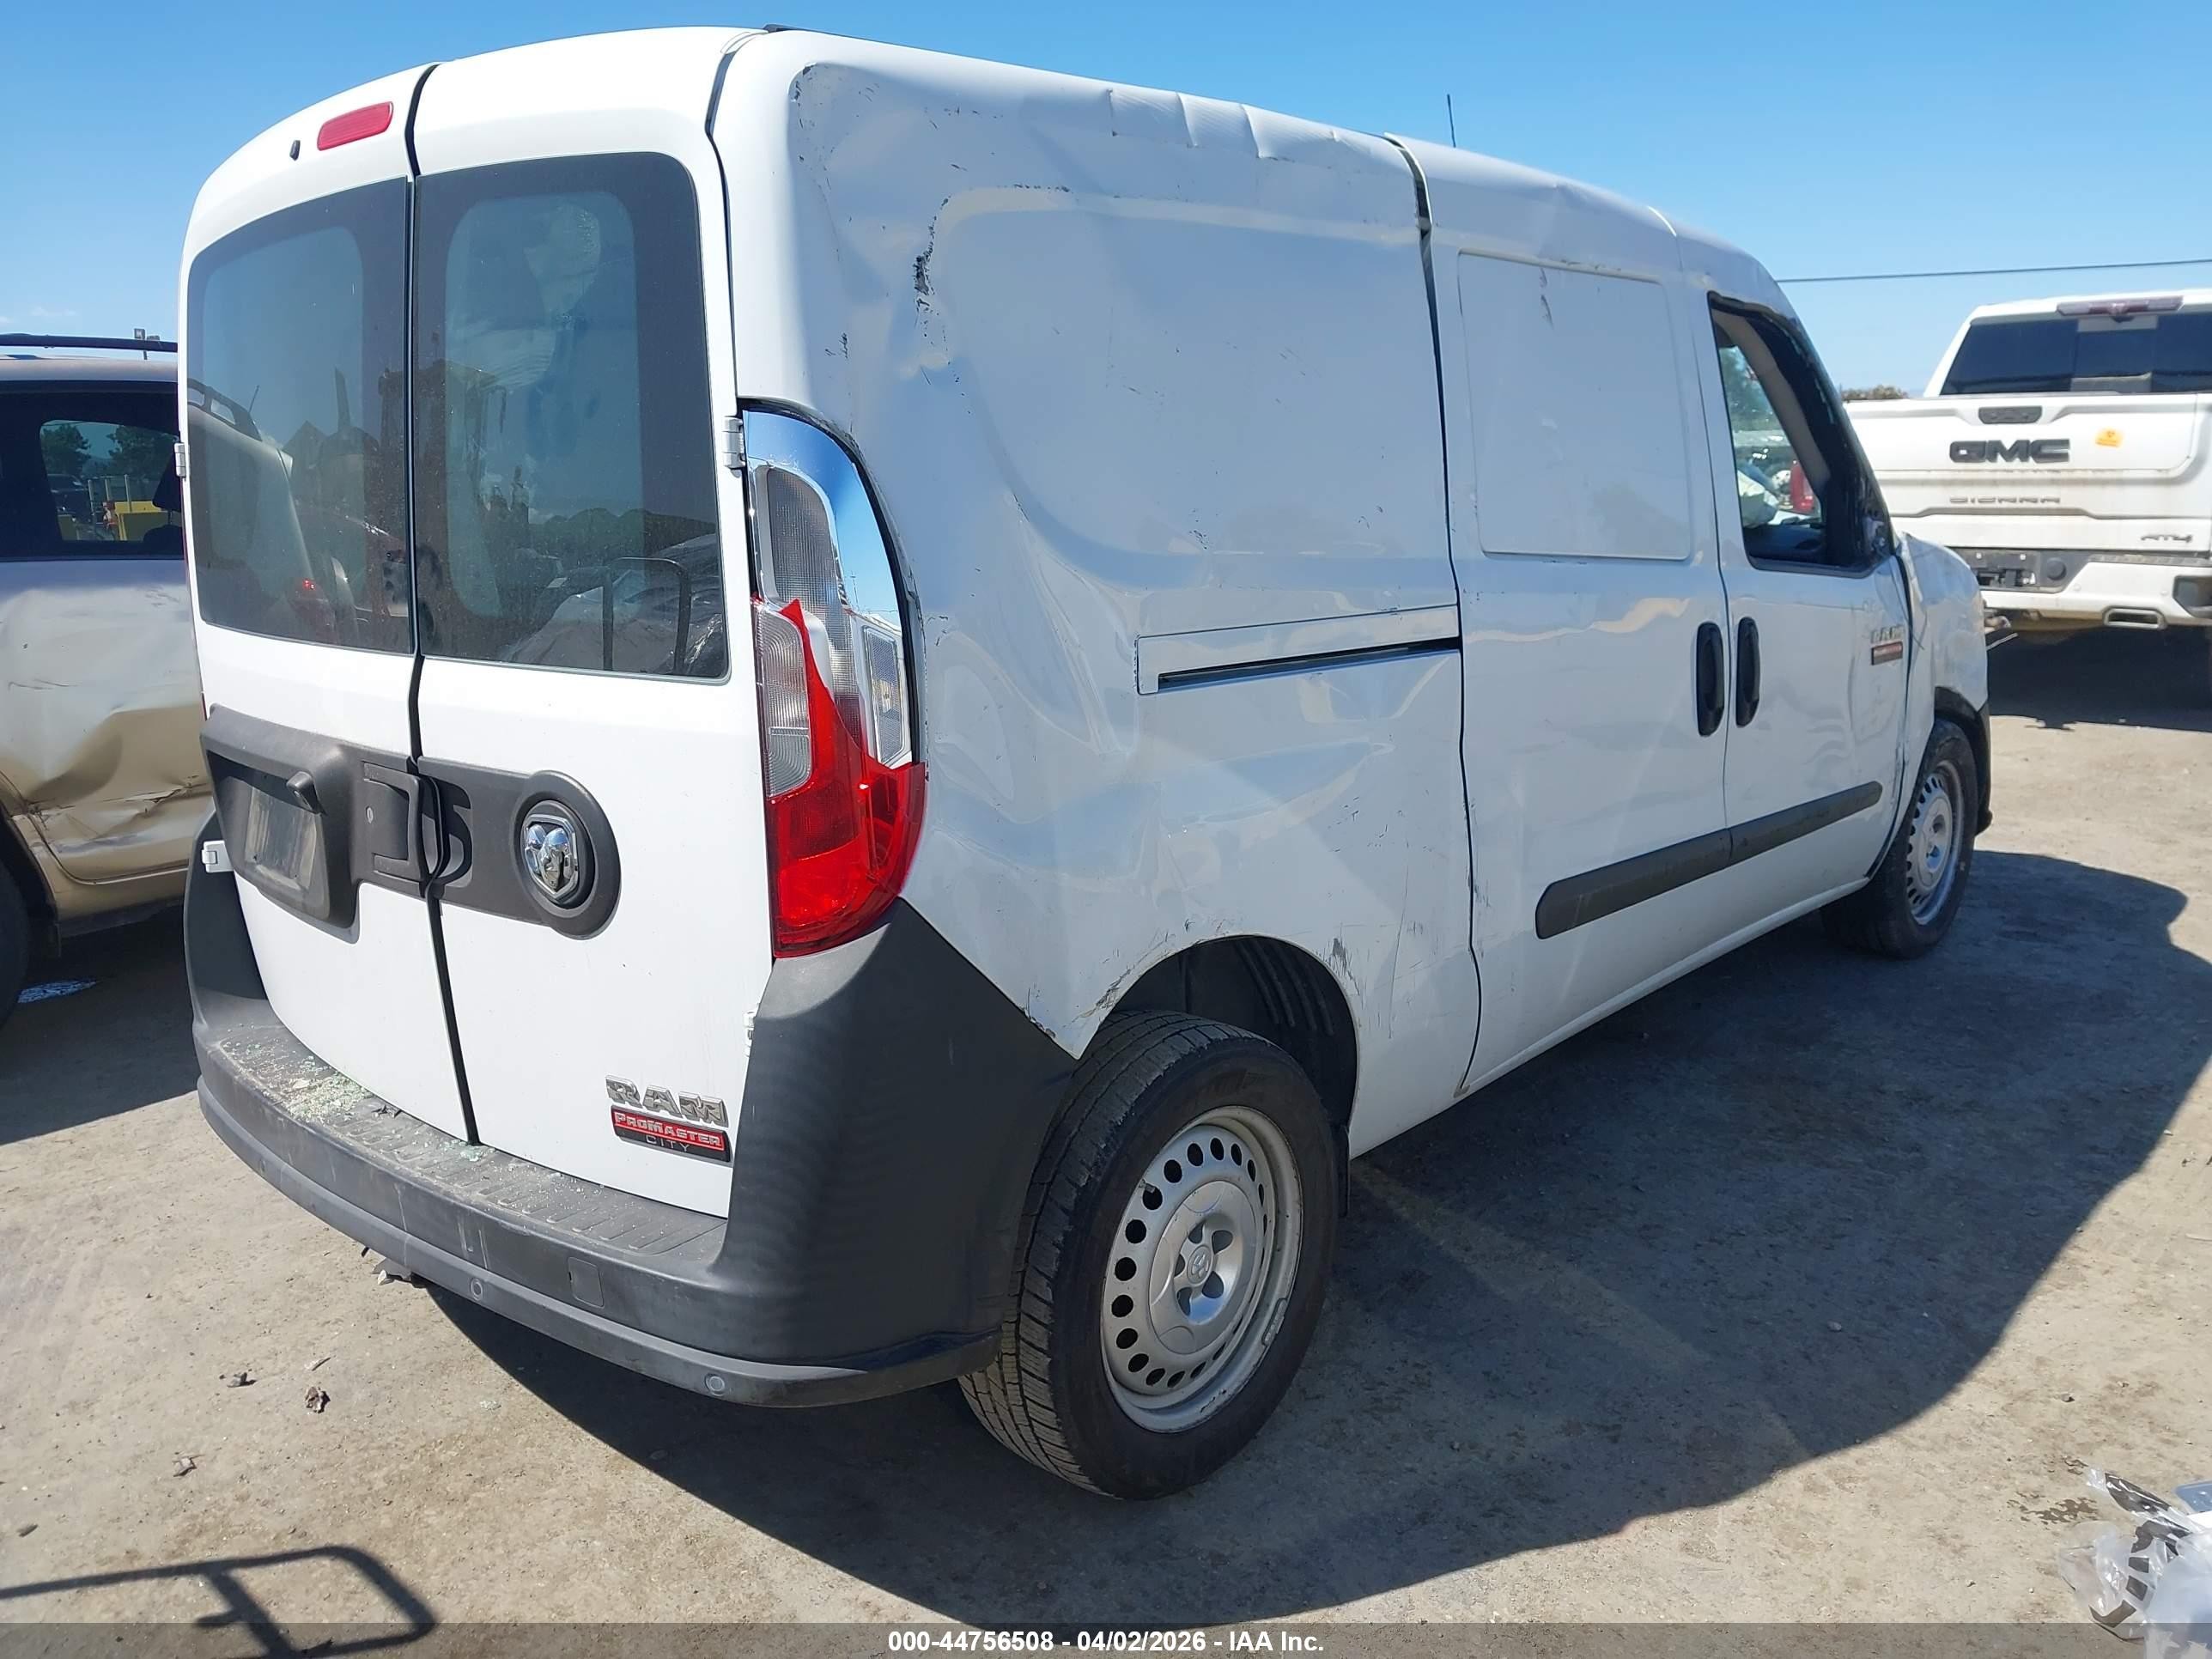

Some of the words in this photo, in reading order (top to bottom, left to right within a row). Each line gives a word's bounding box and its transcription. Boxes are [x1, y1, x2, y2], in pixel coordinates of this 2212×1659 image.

[1949, 439, 2070, 464] GMC
[605, 1075, 730, 1128] RAM
[614, 1111, 723, 1147] PROMASTER
[645, 1135, 691, 1152] CITY
